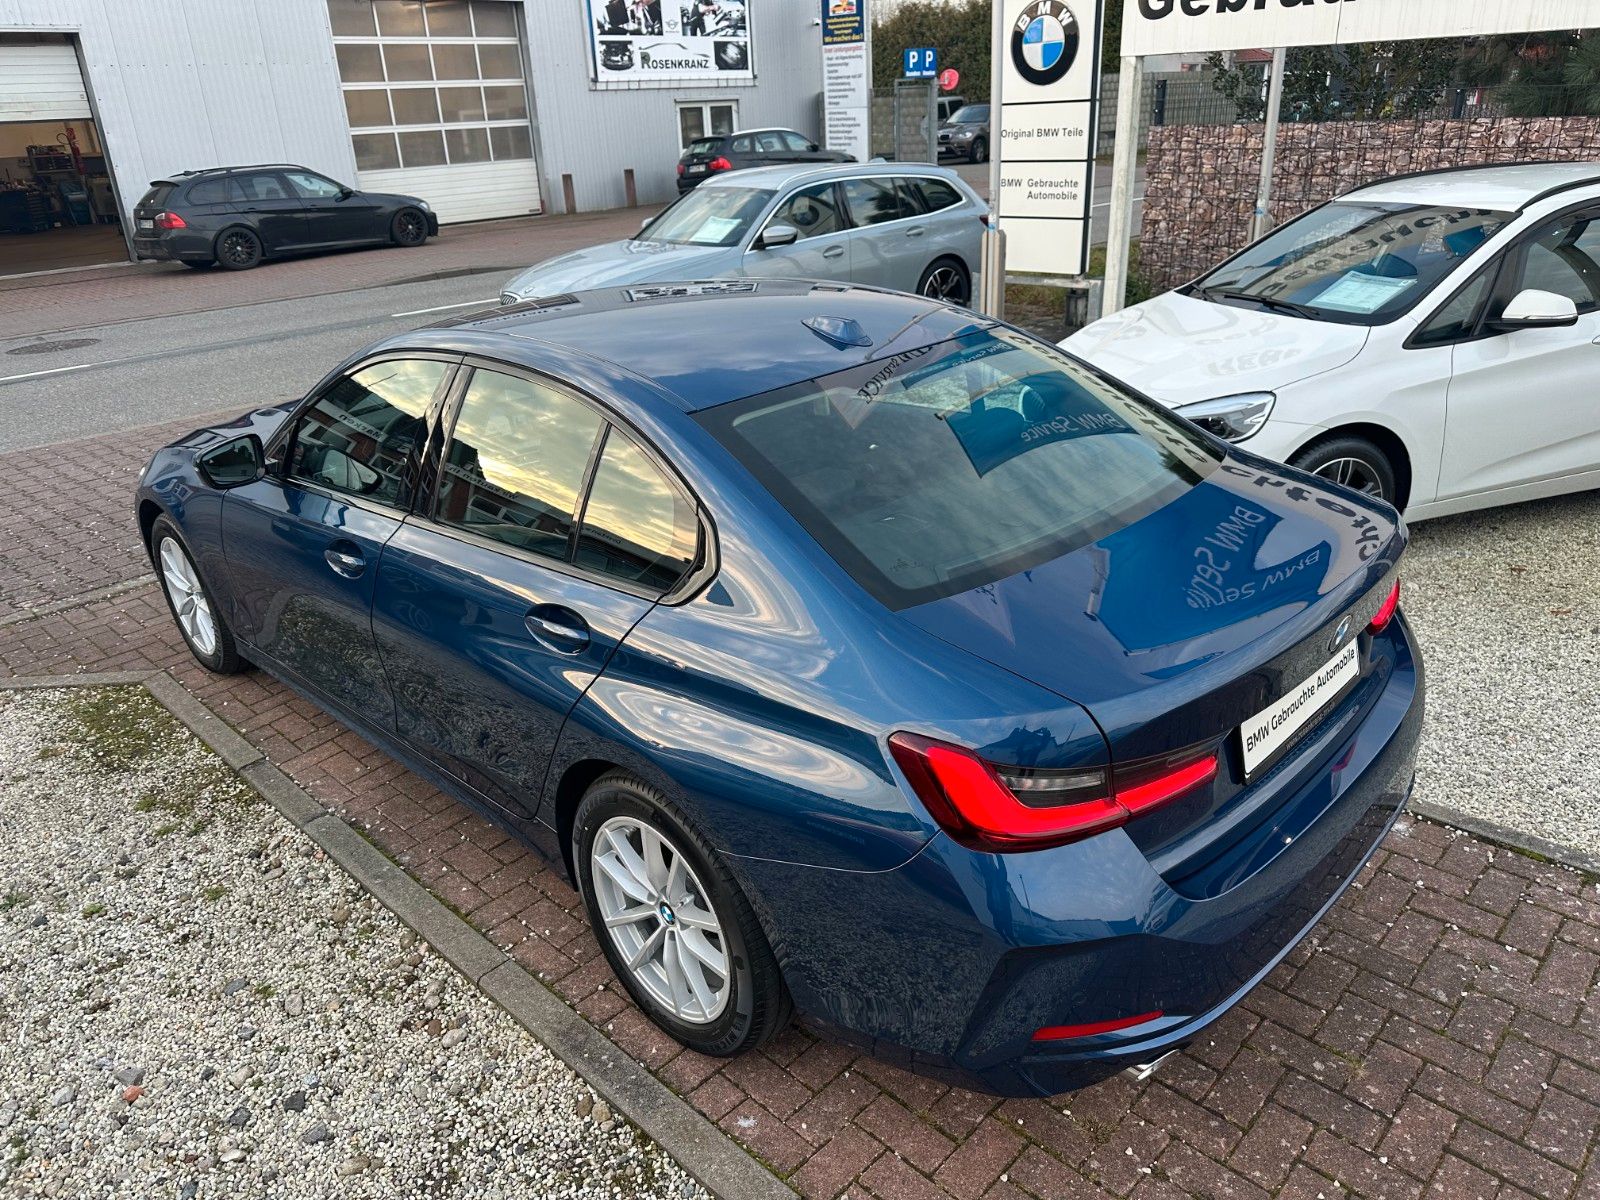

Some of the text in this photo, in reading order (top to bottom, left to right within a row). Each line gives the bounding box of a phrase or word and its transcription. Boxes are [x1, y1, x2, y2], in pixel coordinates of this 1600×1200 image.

[1017, 1, 1074, 30] BMW
[909, 51, 919, 69] P
[925, 50, 934, 68] P
[1001, 127, 1083, 140] Original BMW Teile
[1001, 178, 1079, 188] BMW Gebrauchte
[1027, 191, 1078, 200] Automobile
[1246, 720, 1270, 752] BMW
[1271, 685, 1315, 731] Gebrauchte
[1316, 647, 1355, 691] Automobile
